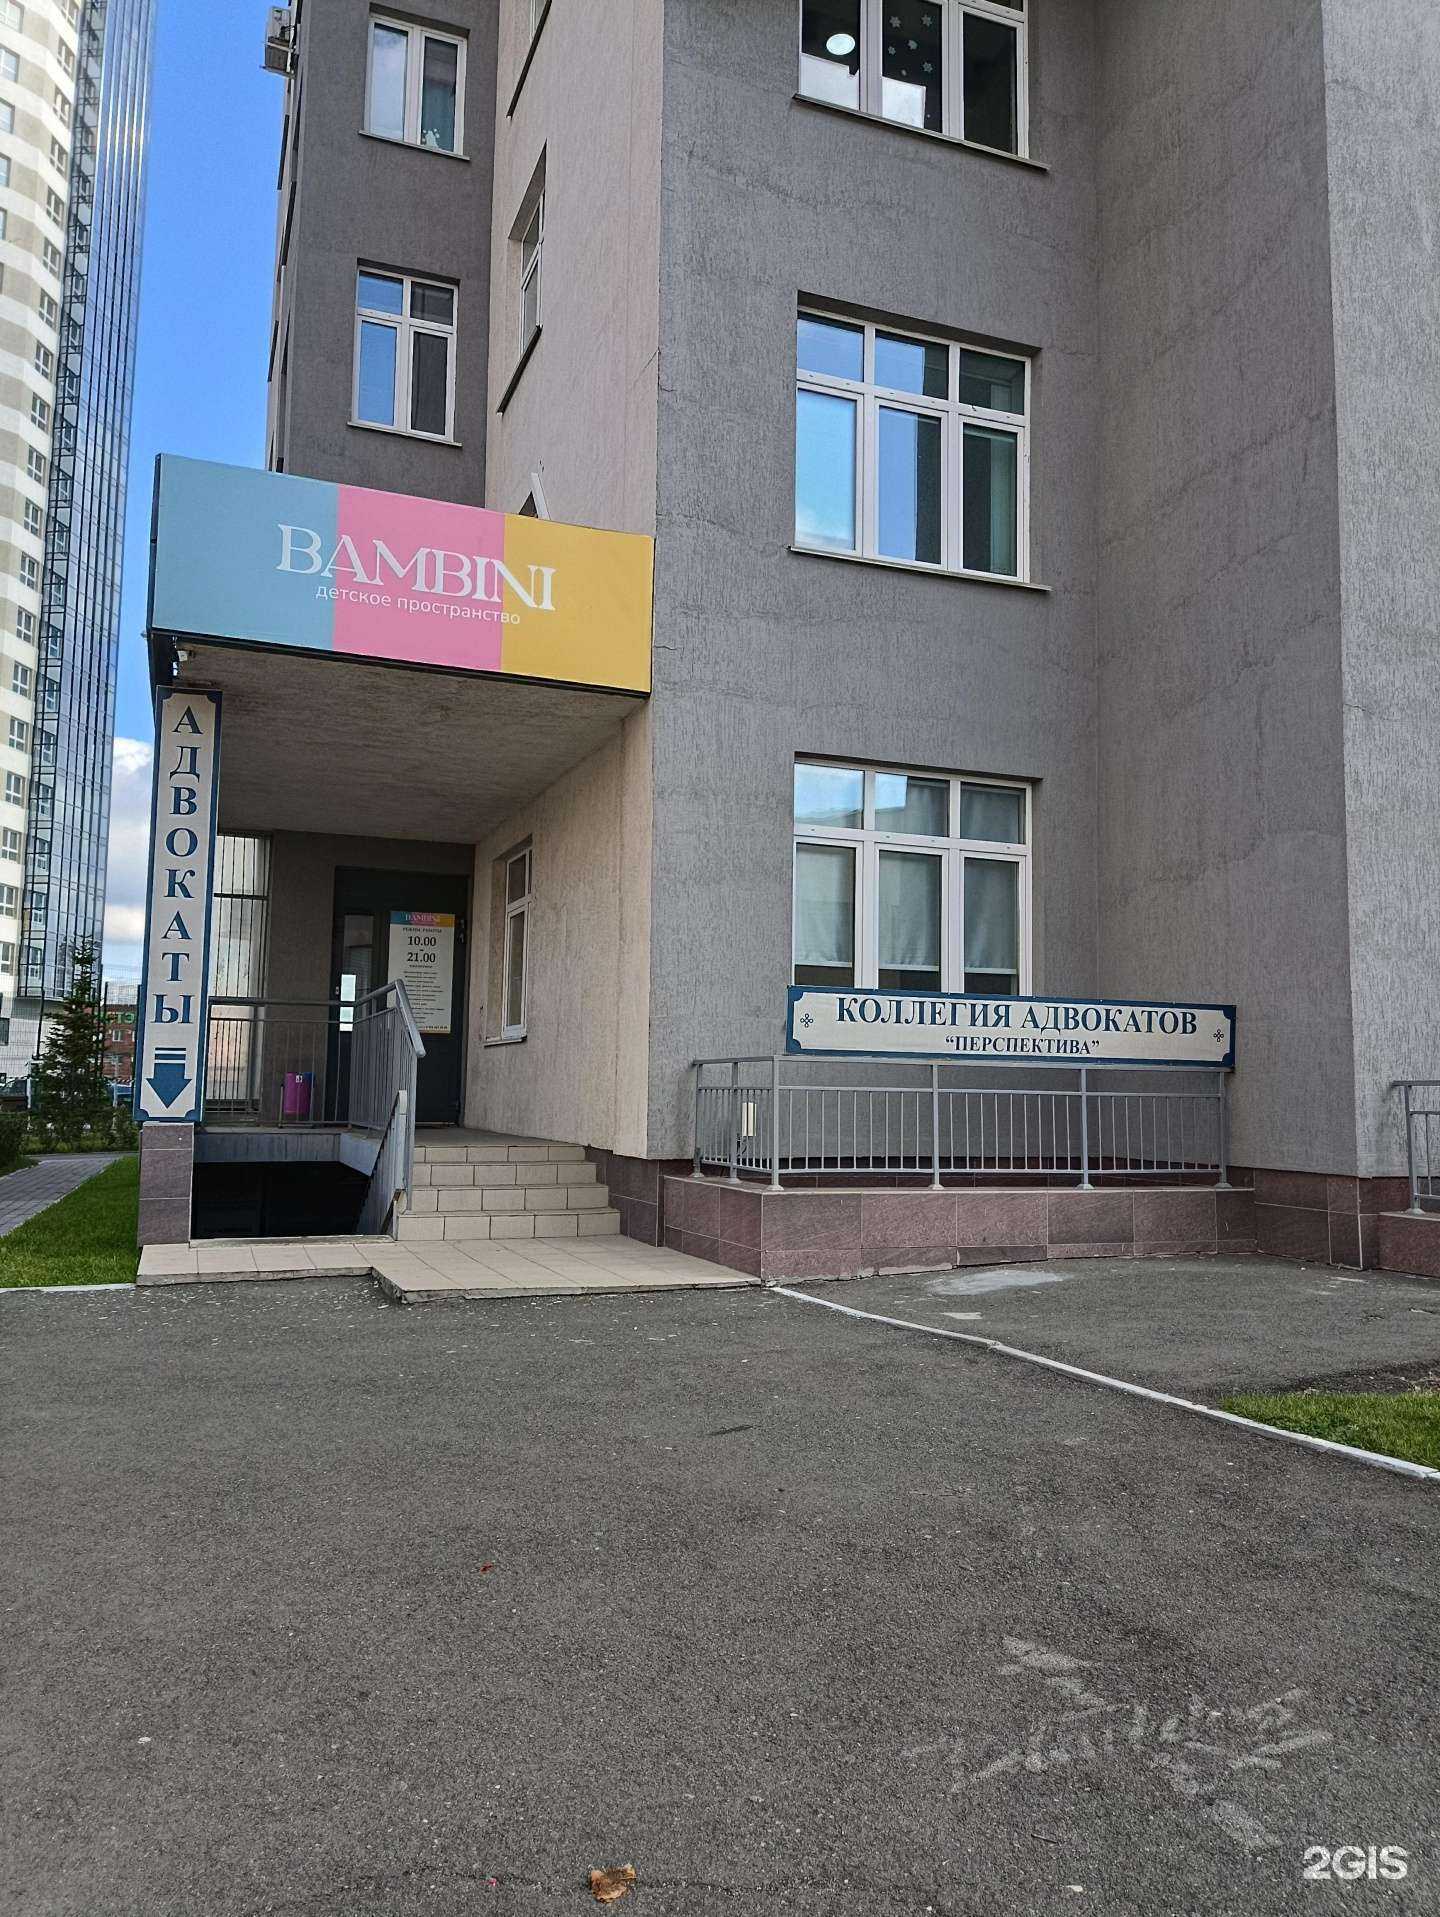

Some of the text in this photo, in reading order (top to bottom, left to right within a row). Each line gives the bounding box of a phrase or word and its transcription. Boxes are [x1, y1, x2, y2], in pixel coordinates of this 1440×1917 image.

[276, 523, 557, 611] BAMBINI
[316, 583, 521, 626] детское пространство
[153, 705, 204, 1025] АДВОКАТЫ
[407, 952, 436, 963] 21.00
[408, 936, 437, 947] 10.00
[836, 997, 1198, 1035] КОЛЛЕГИЯ АДВОКАТОВ
